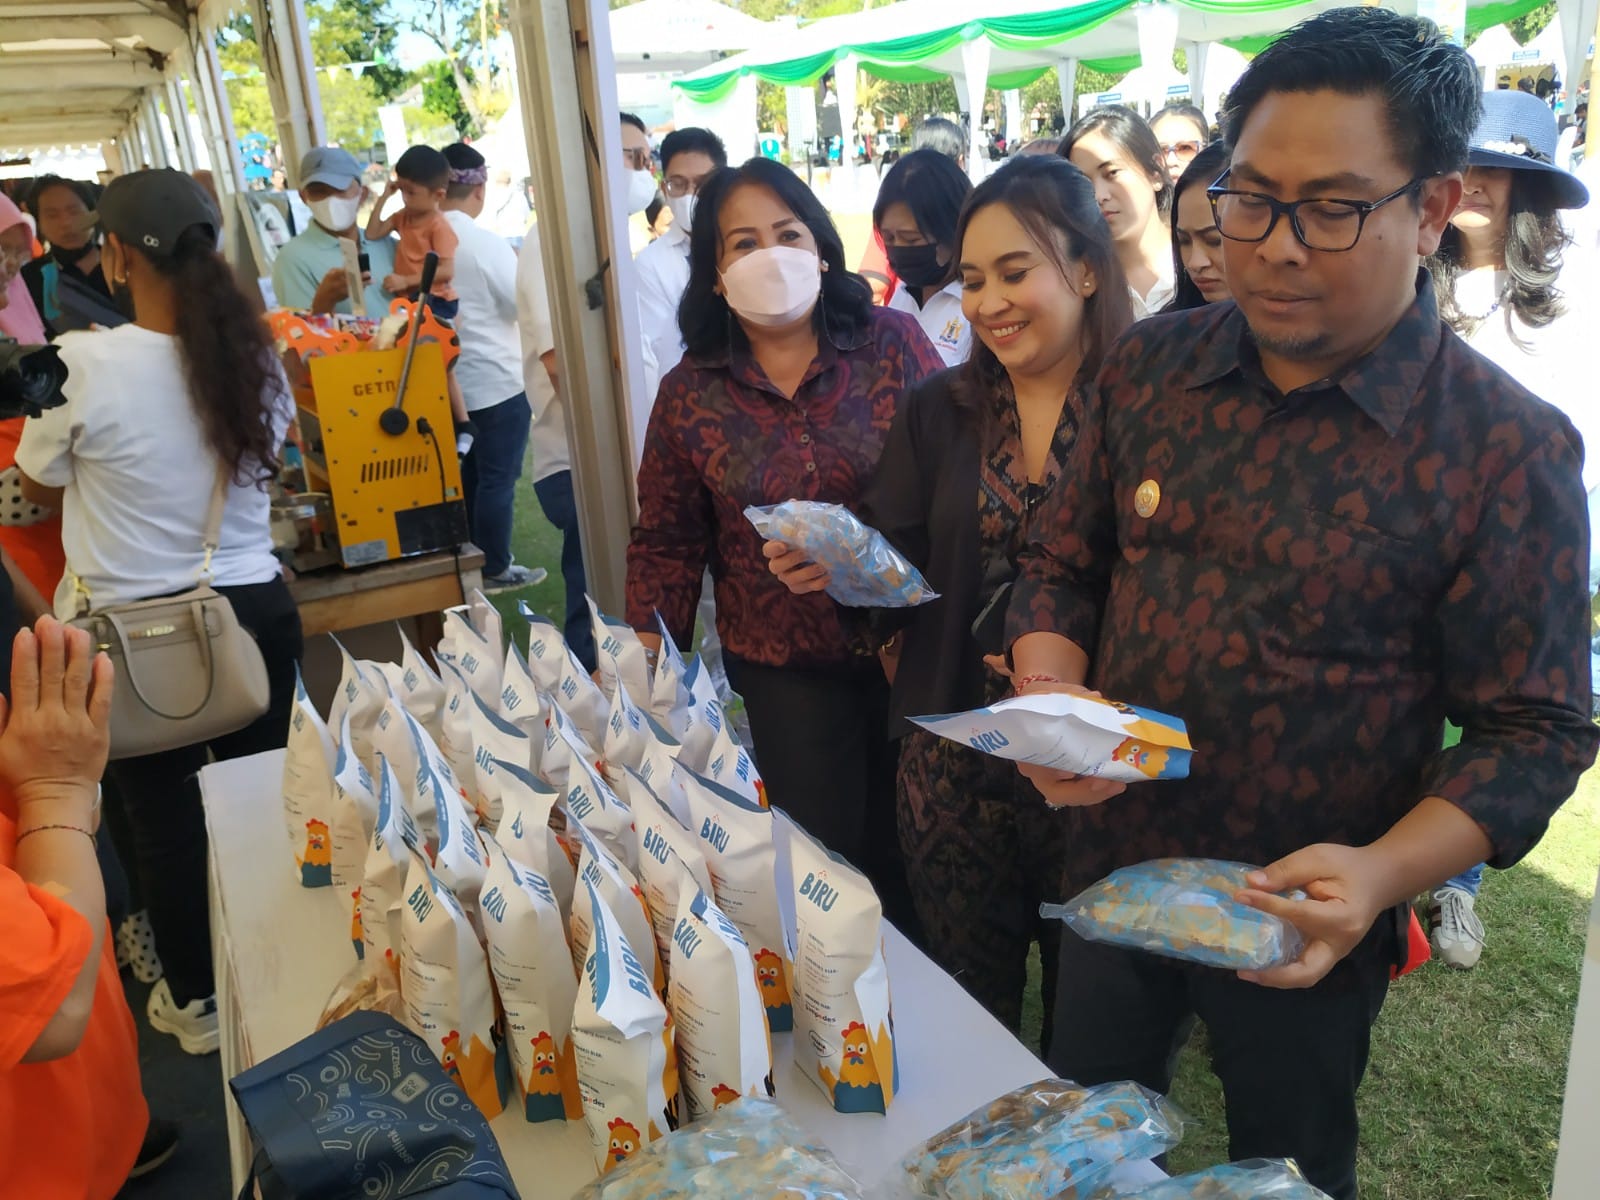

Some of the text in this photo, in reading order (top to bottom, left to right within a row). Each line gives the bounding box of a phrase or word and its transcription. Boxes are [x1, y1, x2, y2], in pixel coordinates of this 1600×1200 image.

[501, 684, 522, 711] BIRU
[969, 729, 1010, 753] BIRU
[567, 785, 595, 820] BIRU
[643, 827, 671, 865] BIRU
[700, 817, 730, 854] BIRU
[407, 884, 434, 923] BIRU
[482, 886, 508, 923] BIRU
[799, 872, 839, 912] BIRU
[673, 918, 703, 960] BIRU
